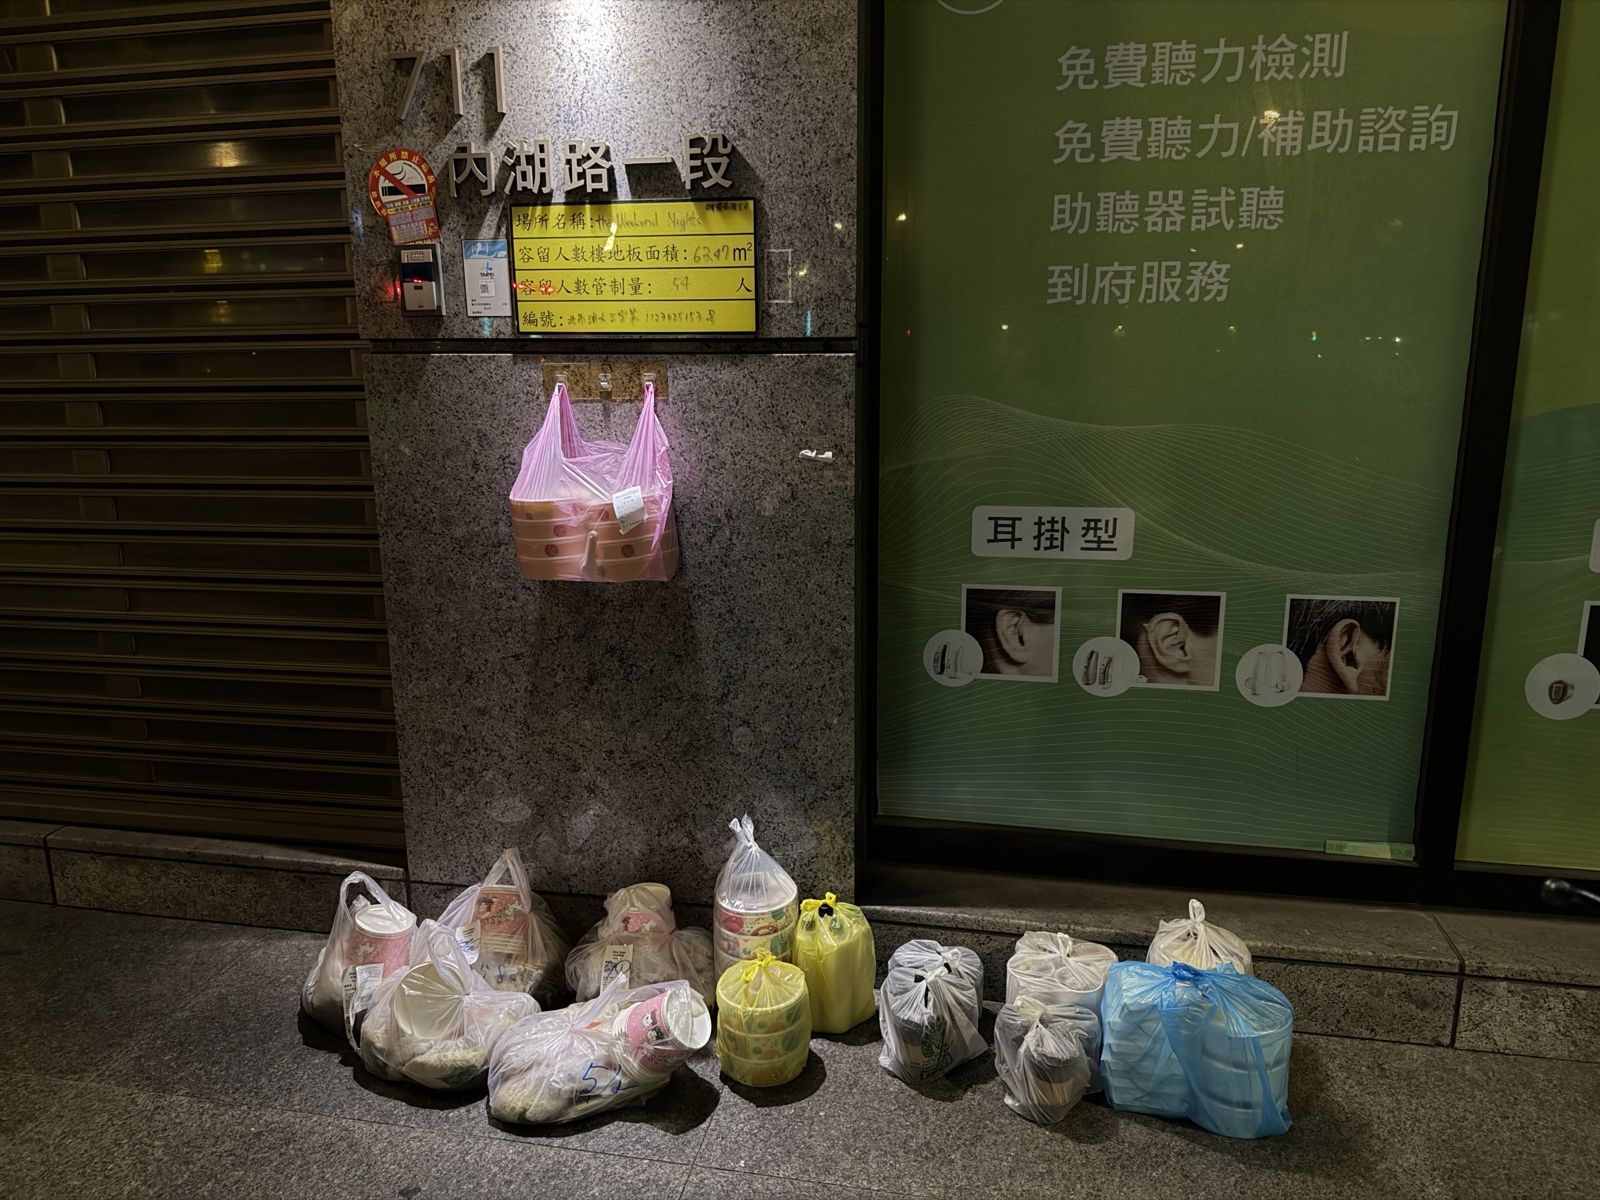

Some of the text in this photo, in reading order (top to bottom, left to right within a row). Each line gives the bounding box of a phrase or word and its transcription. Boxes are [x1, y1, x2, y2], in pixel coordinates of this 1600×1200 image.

[392, 46, 506, 120] 711
[1055, 30, 1350, 92] 免費聽力檢測
[1053, 104, 1460, 165] 免費聽力/補助諮詢
[451, 129, 733, 197] 內湖路一段
[1050, 185, 1285, 235] 助聽器試聽
[736, 277, 752, 293] 人
[1046, 260, 1231, 305] 到府服務
[987, 516, 1118, 551] 耳掛型
